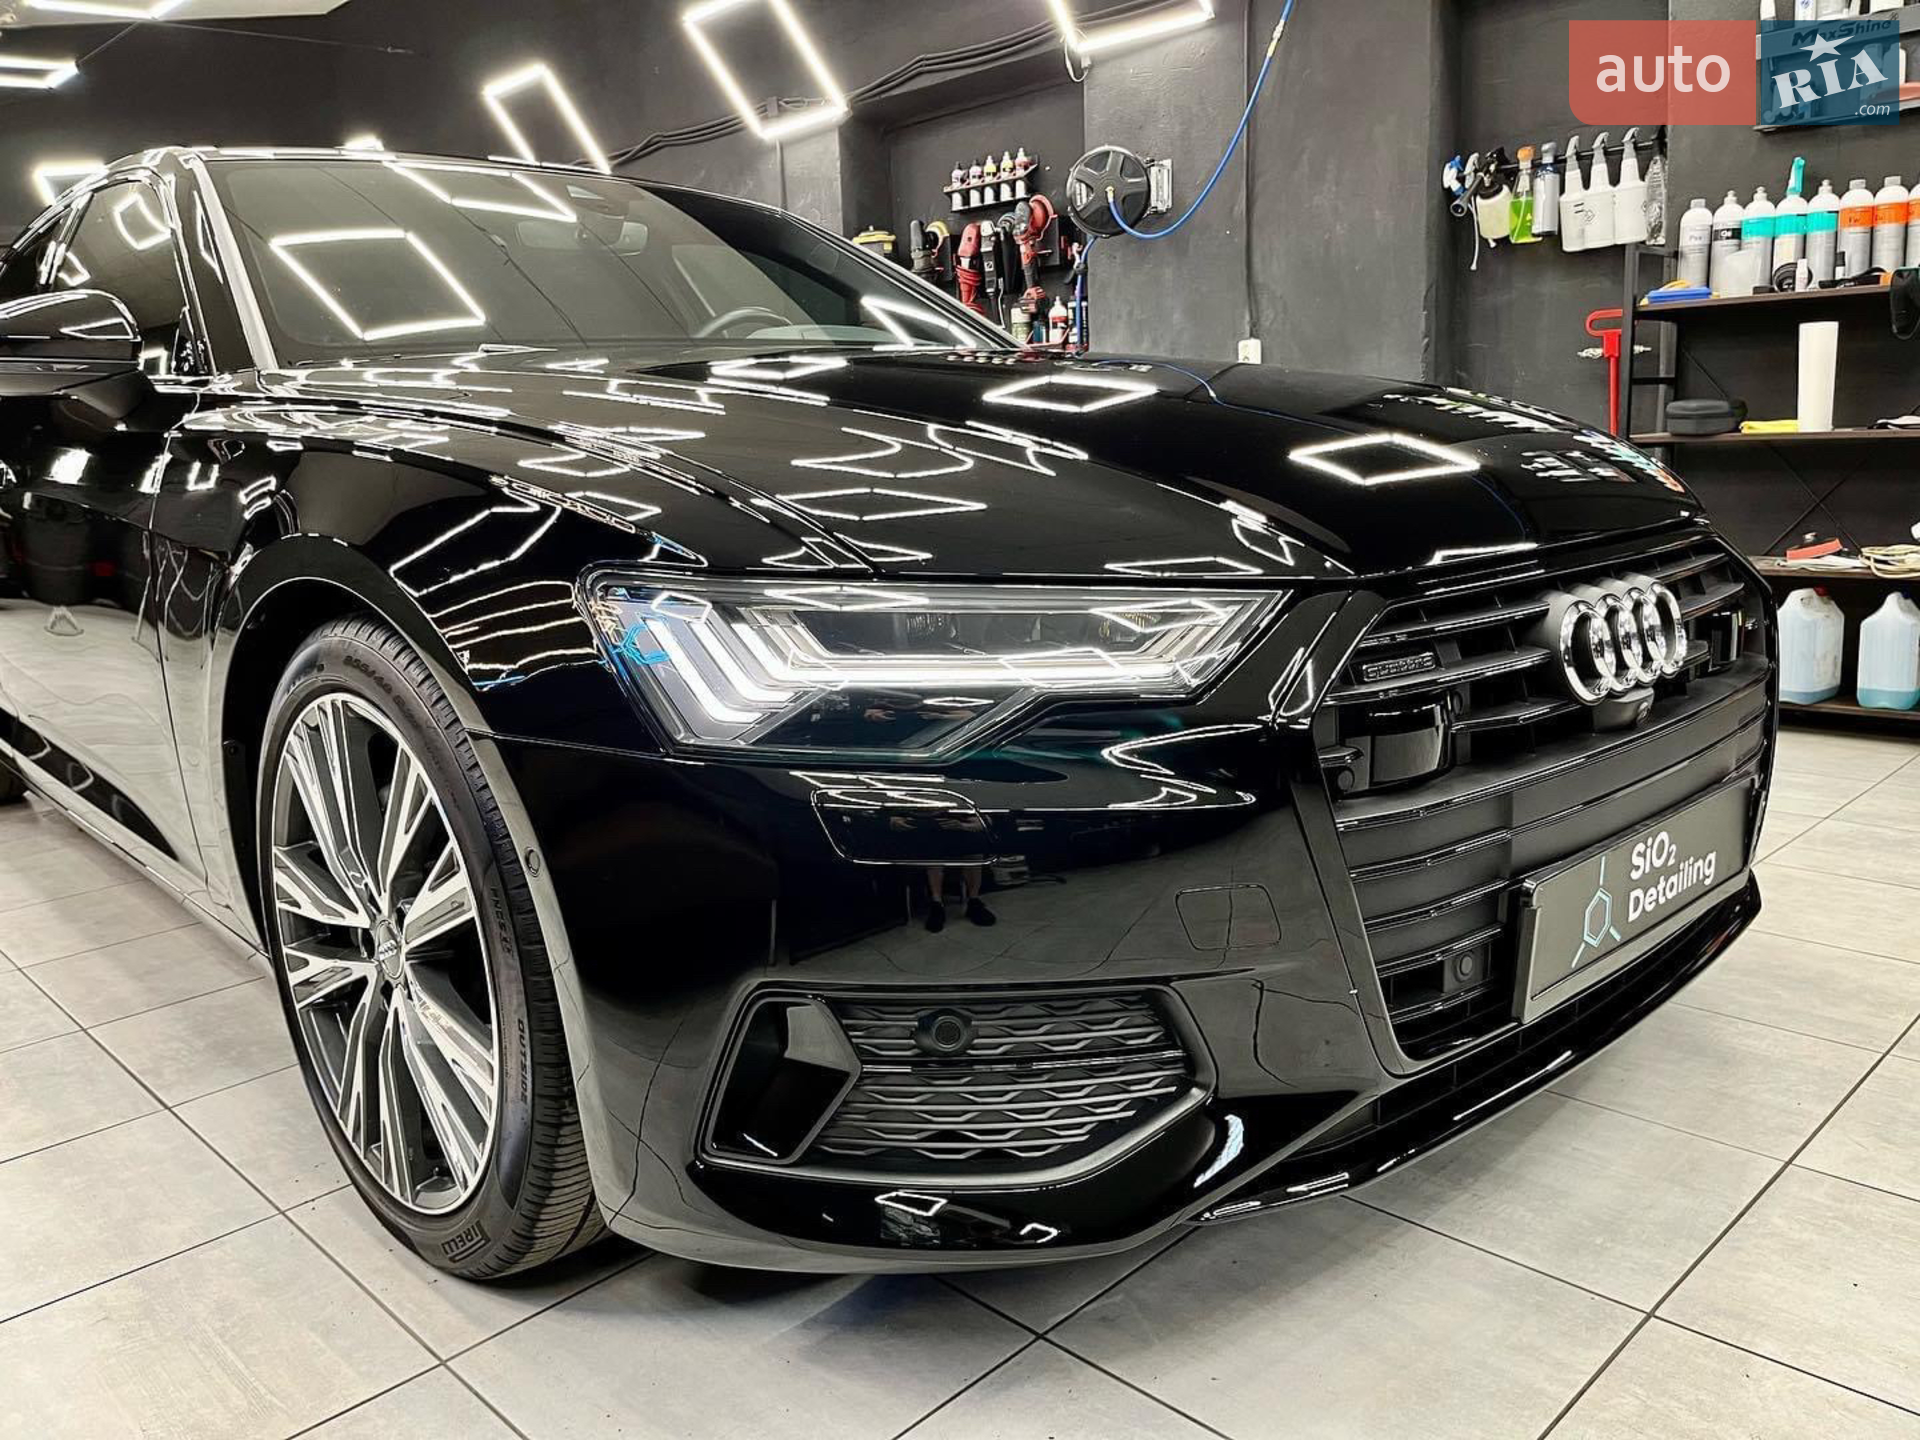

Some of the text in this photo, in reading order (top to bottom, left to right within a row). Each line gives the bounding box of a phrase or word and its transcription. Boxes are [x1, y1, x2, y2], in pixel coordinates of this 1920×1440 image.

[1627, 850, 1718, 923] Detailing
[518, 1017, 531, 1106] OUTSIDE
[441, 1219, 492, 1264] PIRELLI
